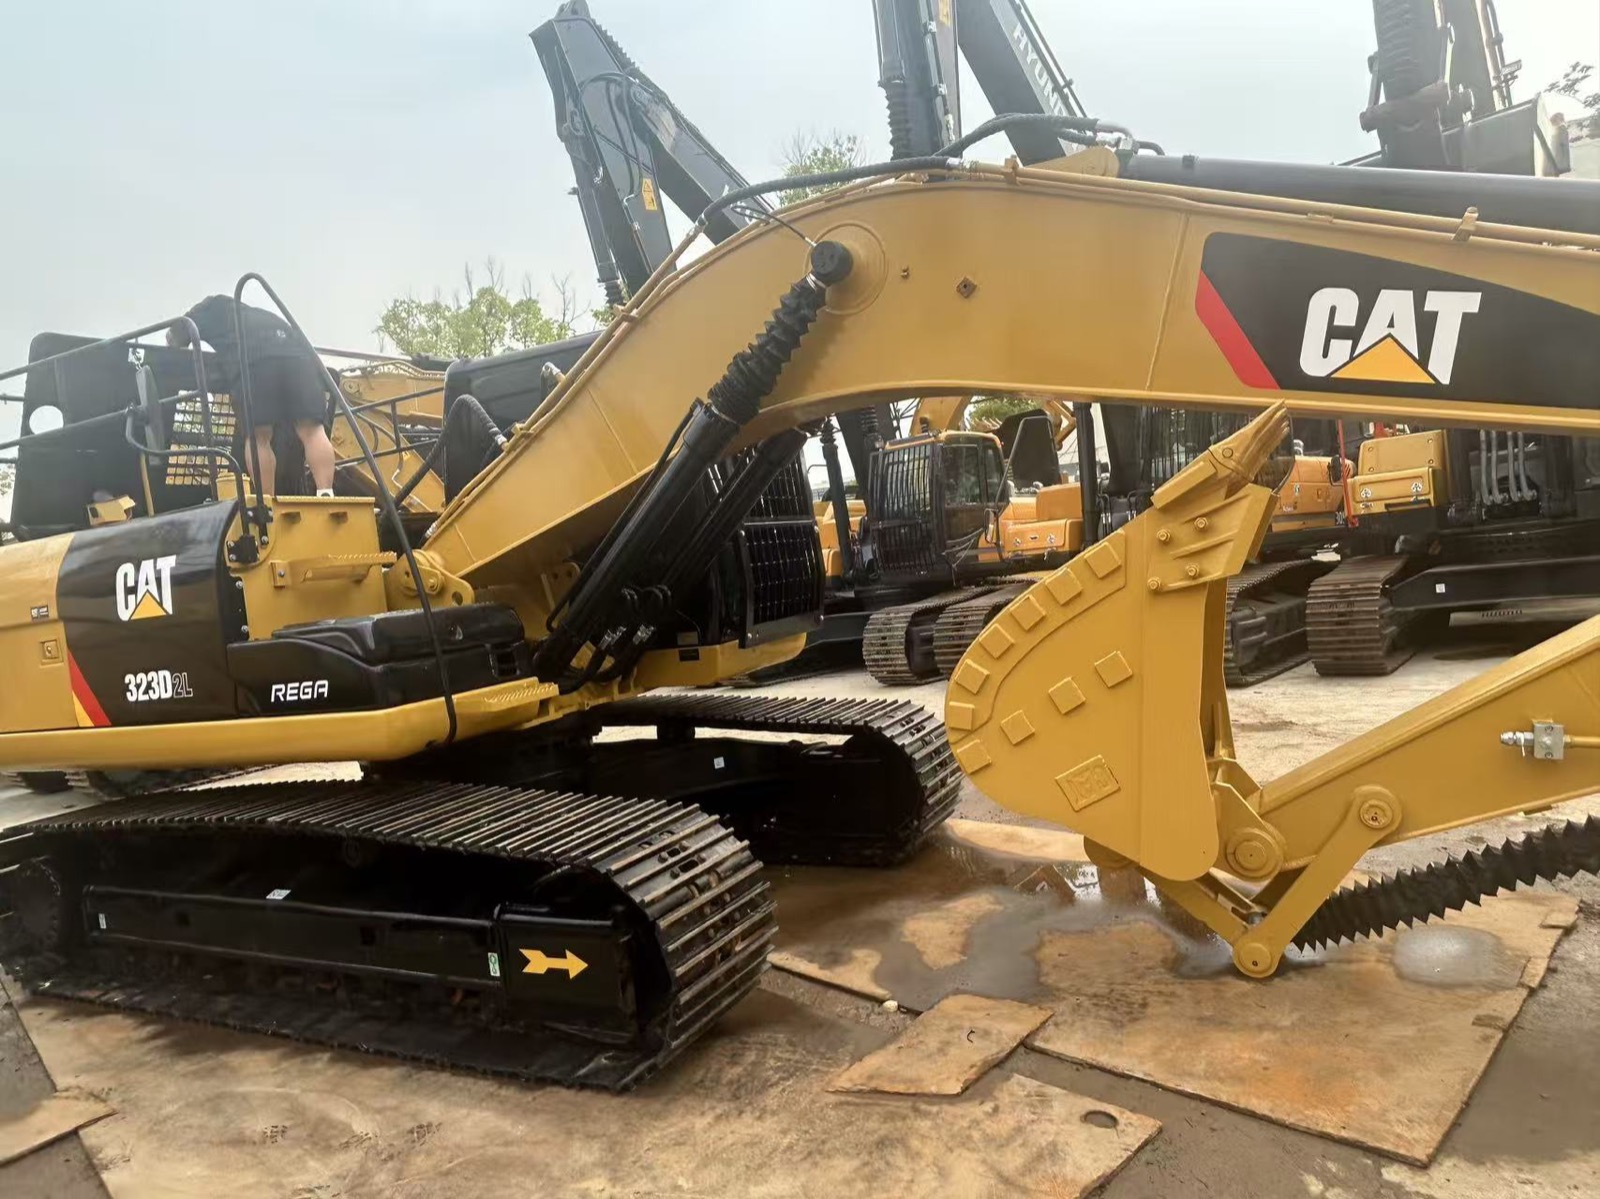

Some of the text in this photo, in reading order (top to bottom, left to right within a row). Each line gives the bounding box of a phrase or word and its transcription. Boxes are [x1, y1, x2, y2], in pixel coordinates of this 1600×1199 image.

[1300, 287, 1482, 385] CAT
[115, 554, 177, 621] CAT
[271, 680, 328, 702] REGA
